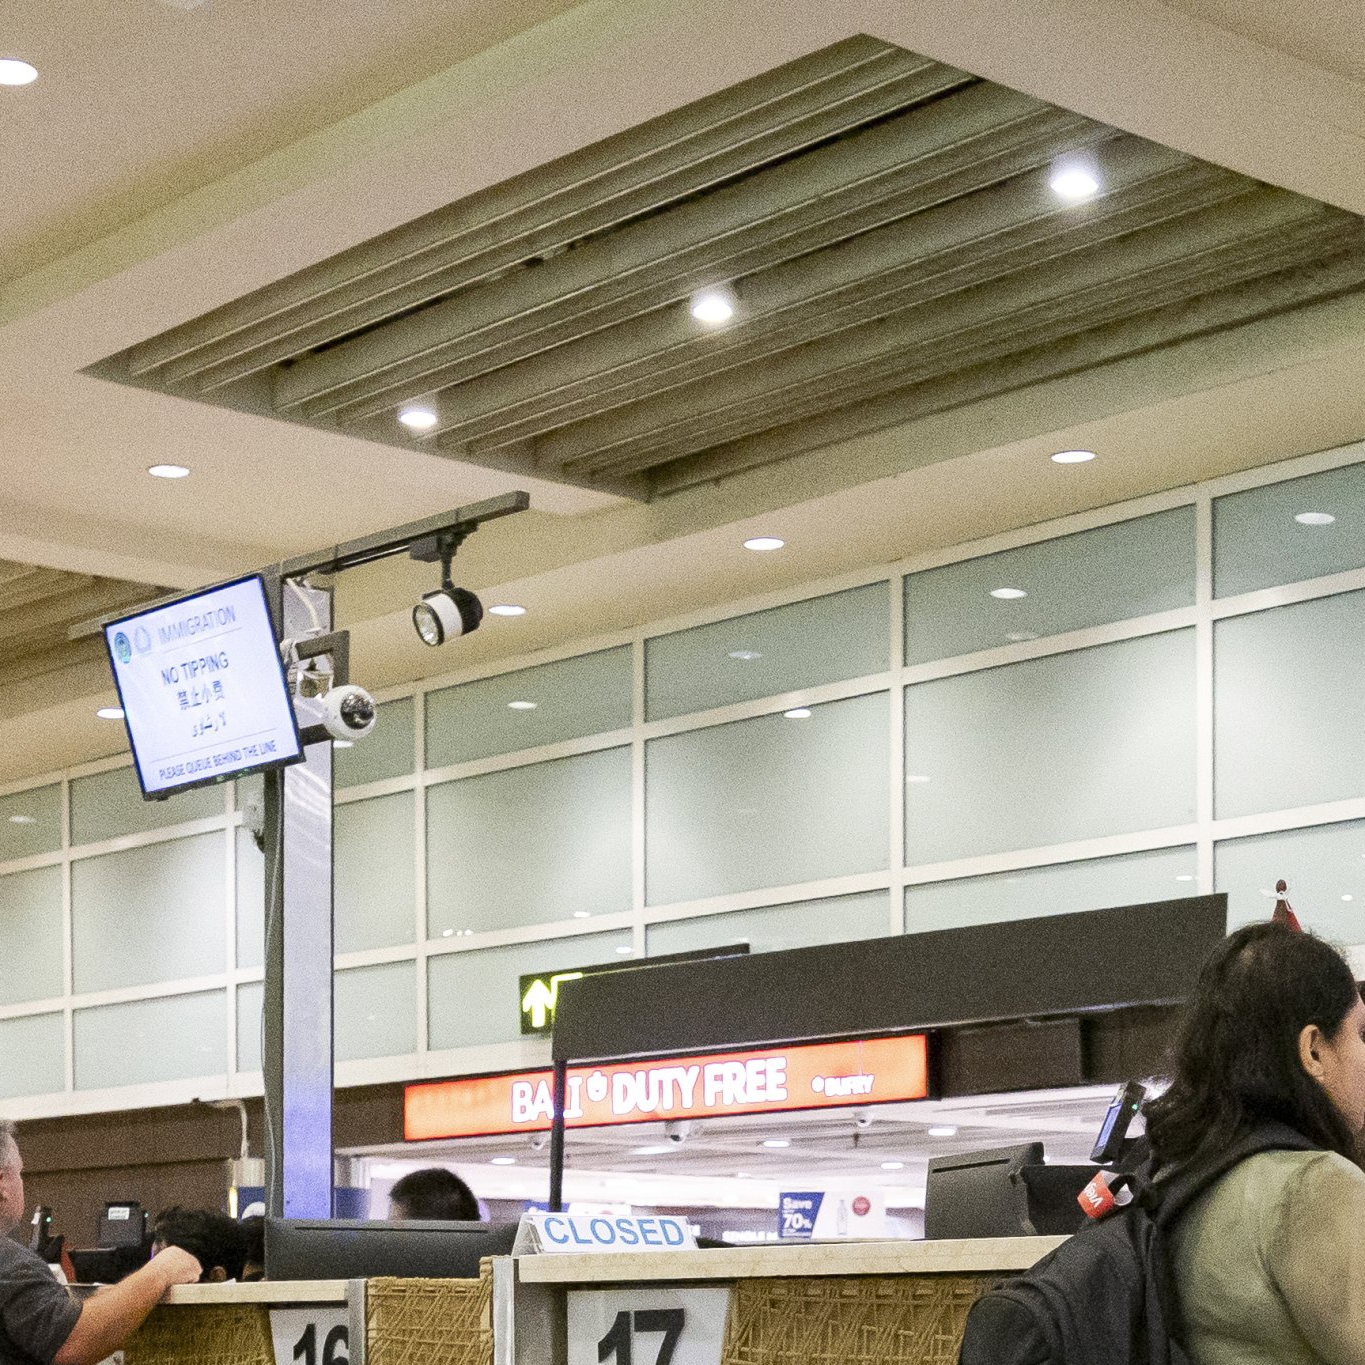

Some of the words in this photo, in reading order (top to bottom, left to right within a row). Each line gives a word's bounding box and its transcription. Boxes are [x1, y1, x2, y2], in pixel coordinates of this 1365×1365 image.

[157, 604, 235, 645] IMMIGRATION
[161, 666, 180, 687] NO
[182, 651, 229, 680] TIPPING
[611, 1065, 701, 1115] DUTY
[704, 1056, 787, 1108] FREE
[544, 1216, 685, 1246] CLOSED
